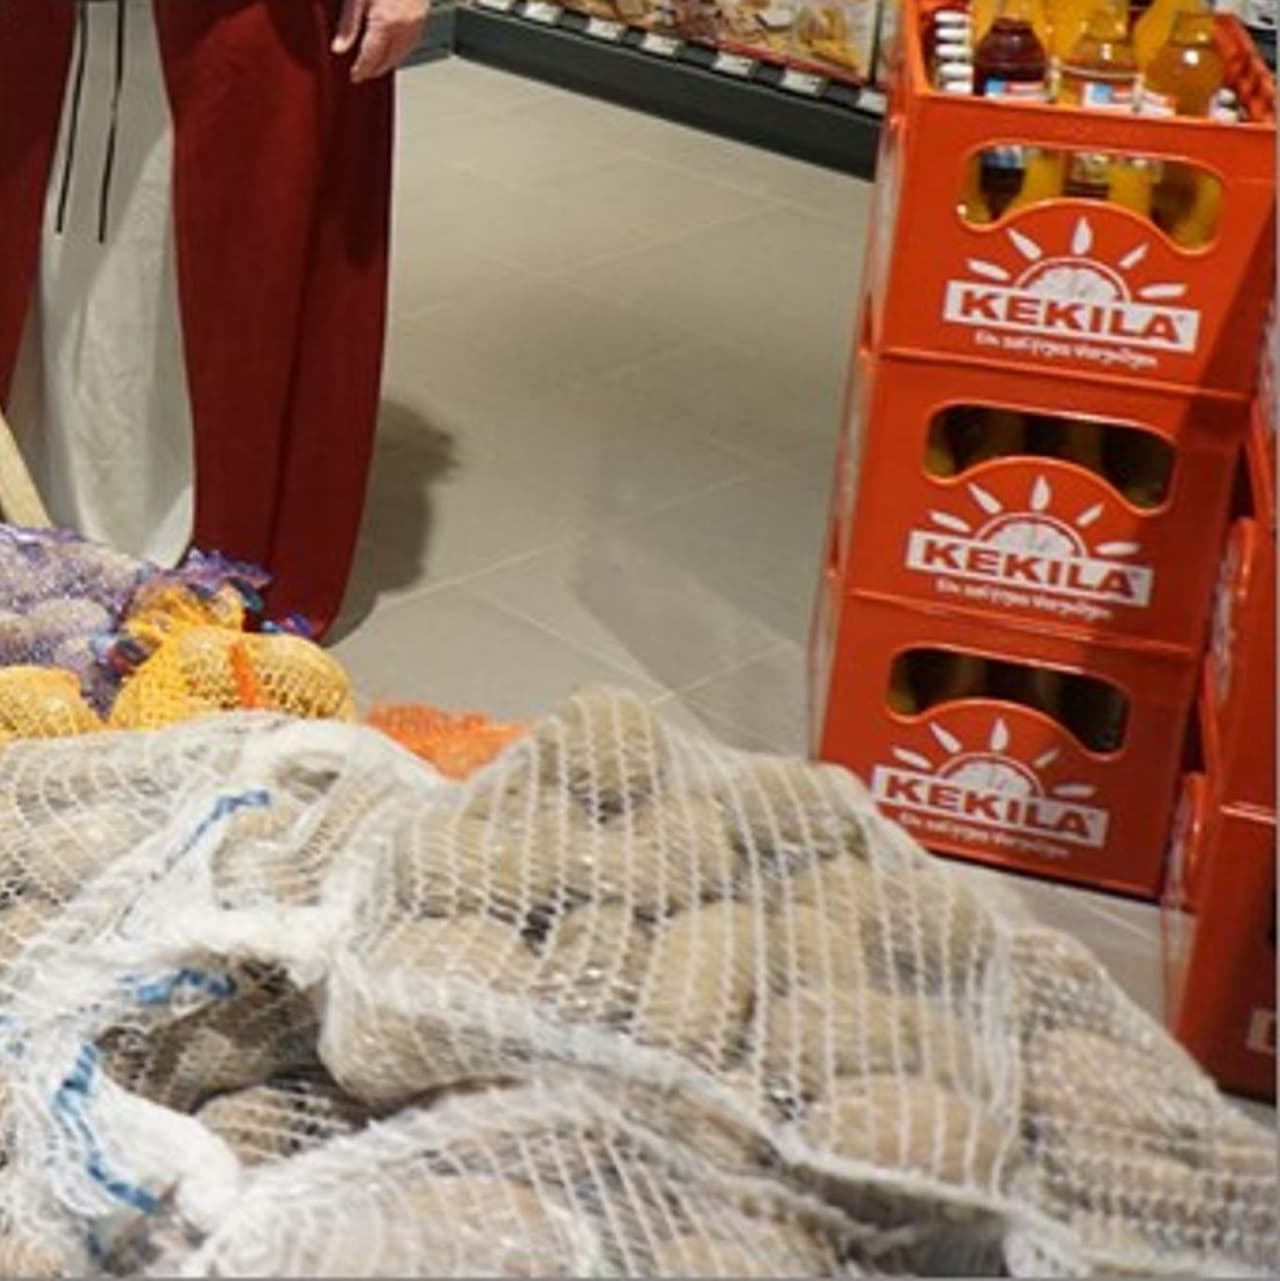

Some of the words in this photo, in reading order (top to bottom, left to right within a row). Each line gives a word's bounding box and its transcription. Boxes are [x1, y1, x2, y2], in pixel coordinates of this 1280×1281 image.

[960, 290, 1180, 344] KEKILA
[922, 539, 1137, 598] KEKILA
[884, 773, 1092, 838] KEKILA
